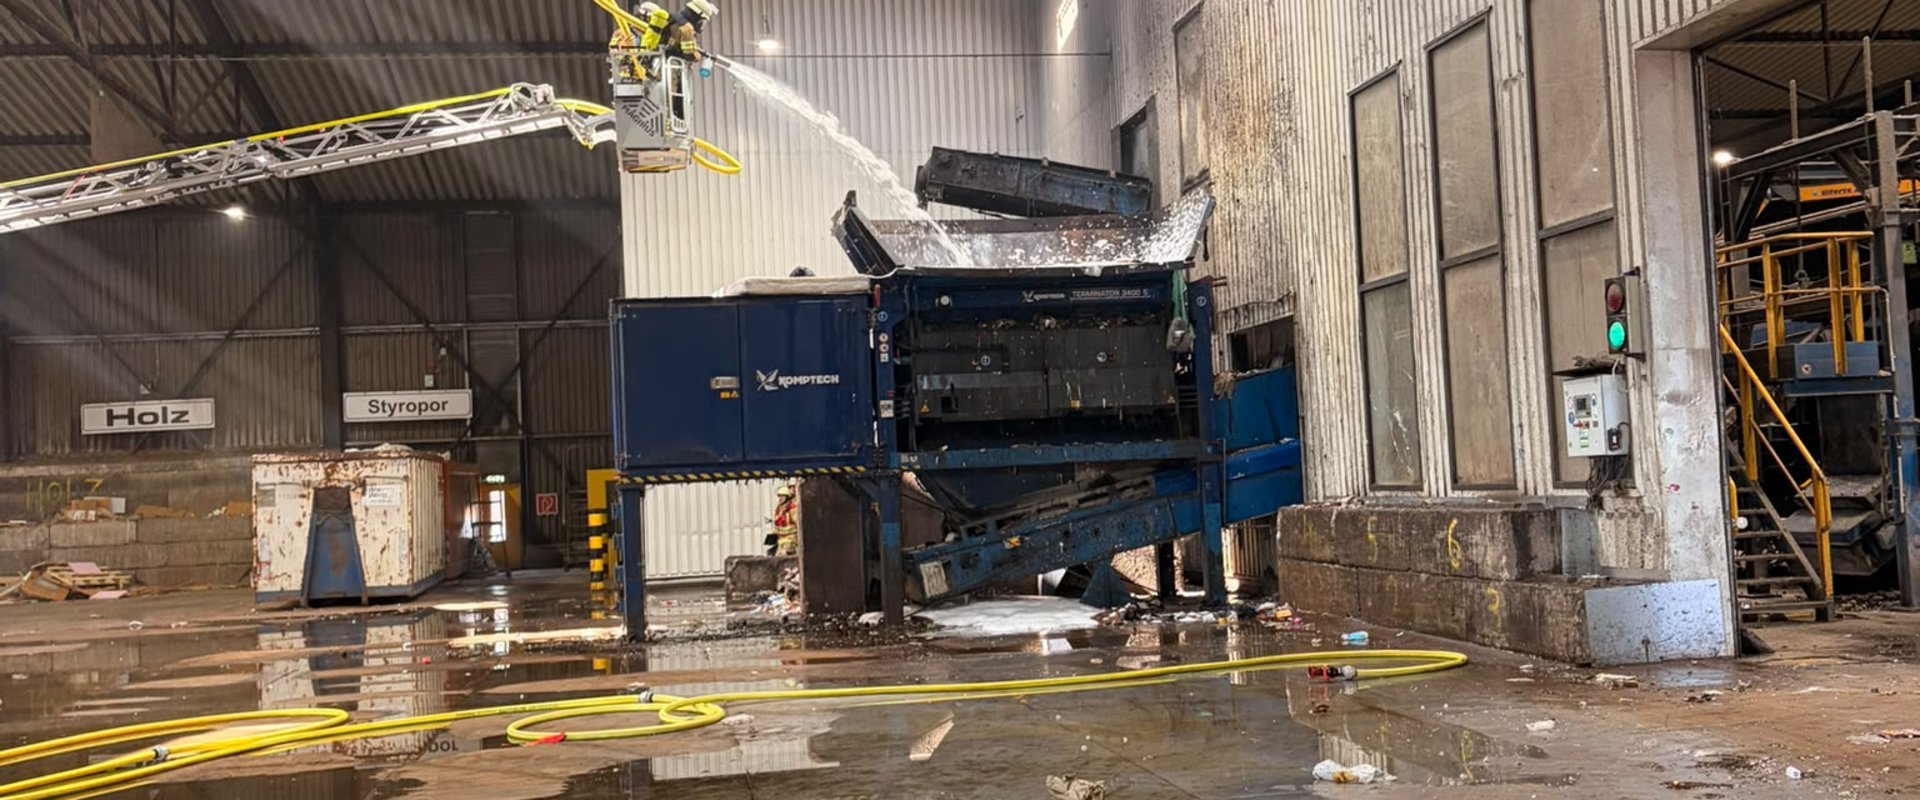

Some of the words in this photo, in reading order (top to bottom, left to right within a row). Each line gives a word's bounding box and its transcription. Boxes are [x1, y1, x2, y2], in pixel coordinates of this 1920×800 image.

[778, 374, 840, 389] KOMPTECH
[105, 405, 191, 427] Holz
[368, 399, 449, 418] Styropor
[1447, 517, 1463, 571] 6
